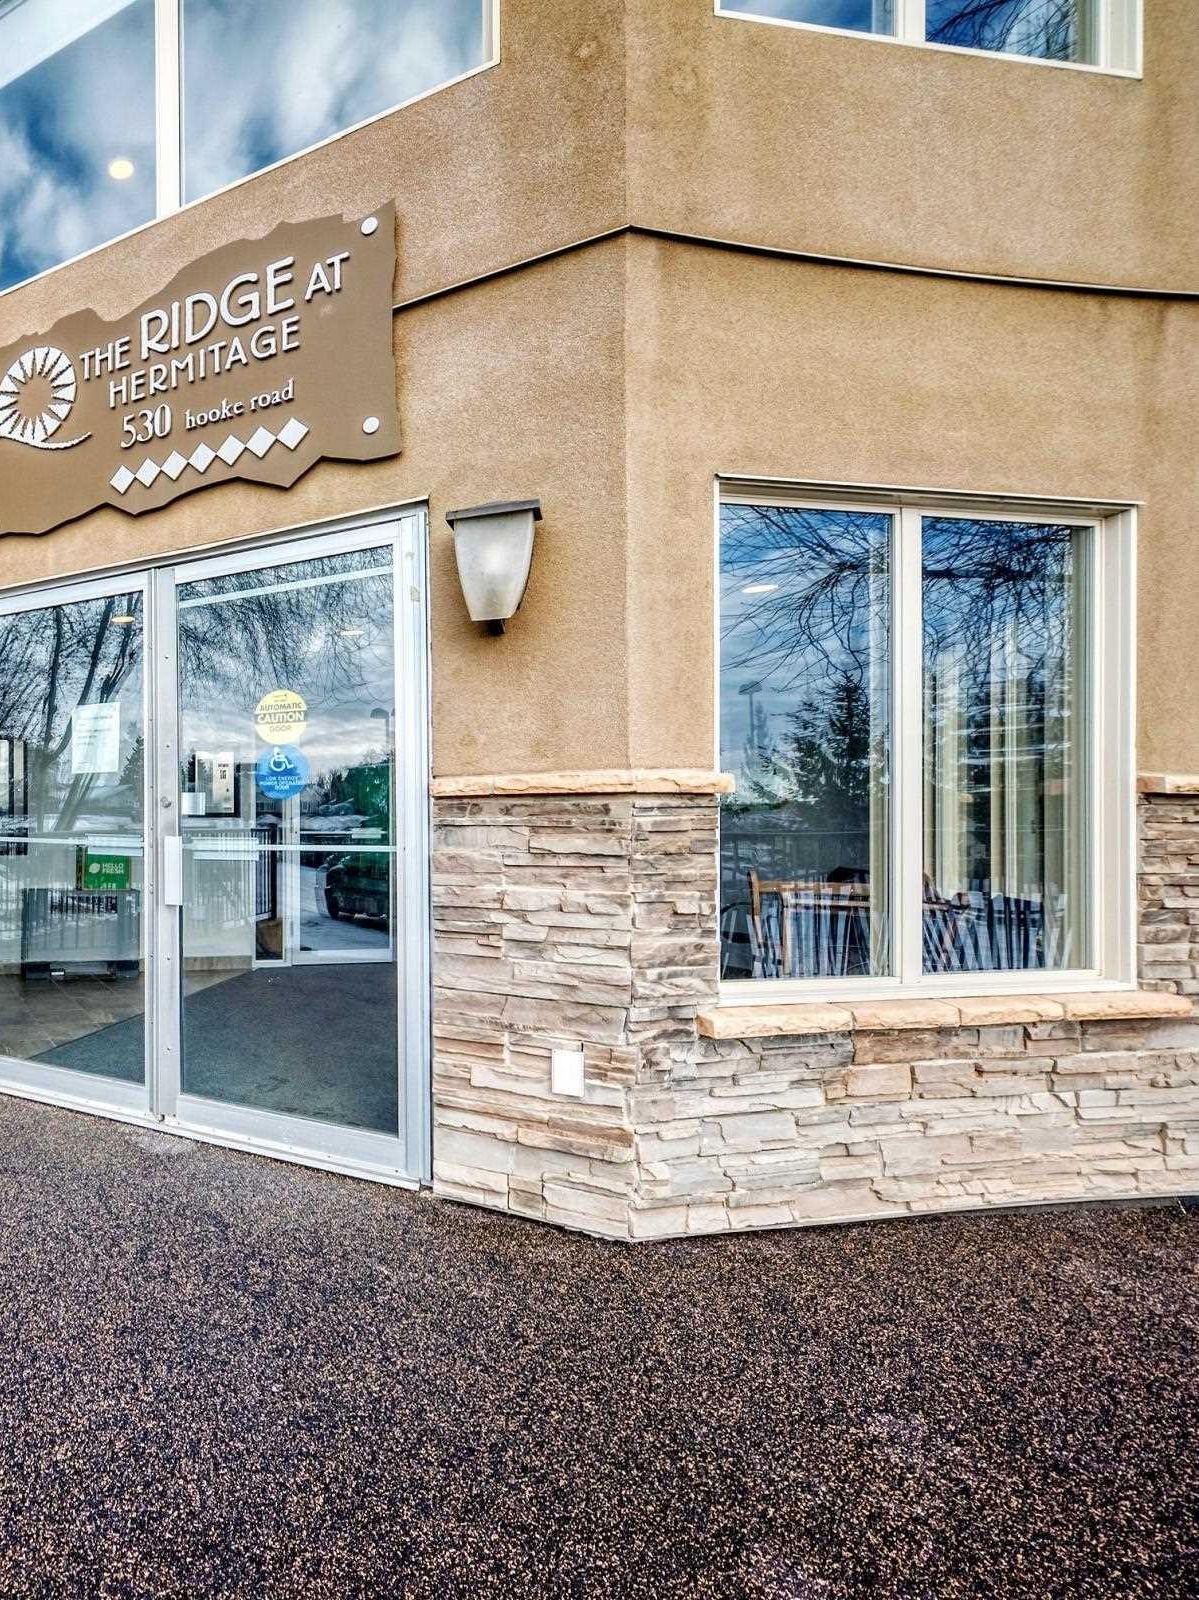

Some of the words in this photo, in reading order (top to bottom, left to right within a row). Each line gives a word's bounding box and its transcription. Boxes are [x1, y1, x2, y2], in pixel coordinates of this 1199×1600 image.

[79, 335, 132, 382] THE
[139, 255, 297, 361] RIDGE
[304, 251, 351, 301] AT
[108, 315, 301, 409] HERMITAGE
[121, 402, 173, 449] 530
[186, 396, 245, 431] hooke
[249, 379, 296, 411] road
[257, 711, 305, 723] CAUTION
[259, 703, 302, 711] AUTOMATIC
